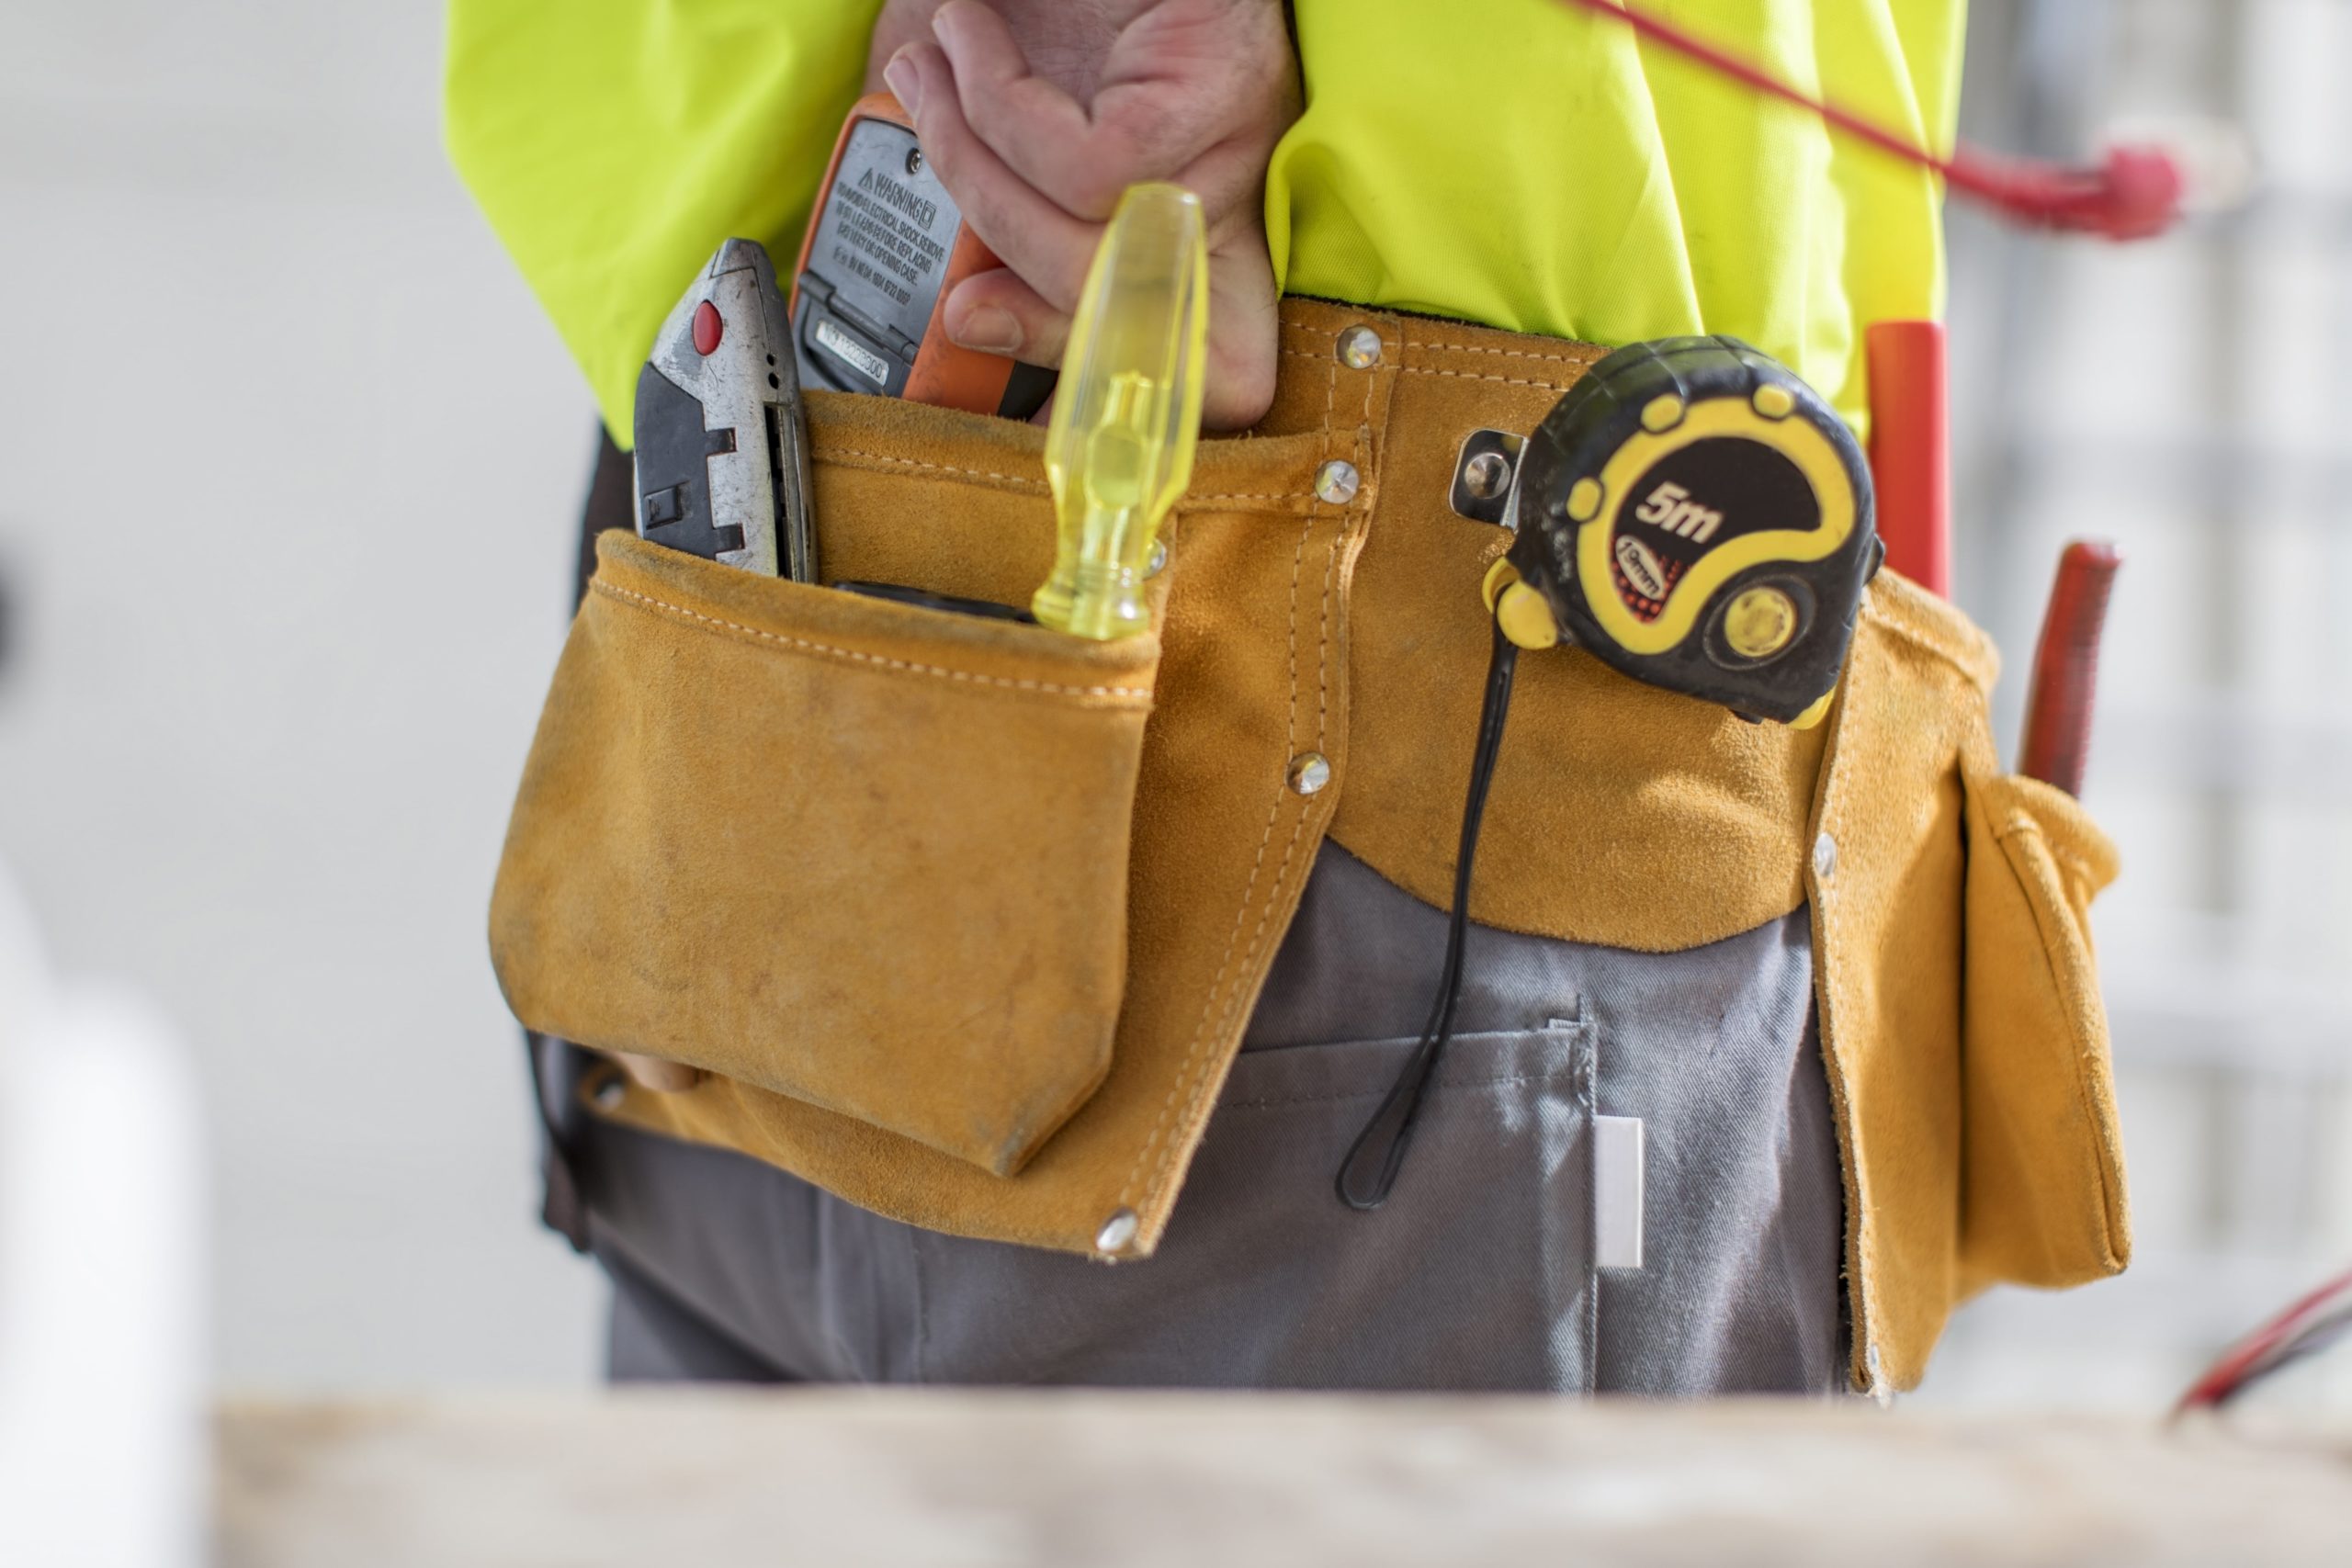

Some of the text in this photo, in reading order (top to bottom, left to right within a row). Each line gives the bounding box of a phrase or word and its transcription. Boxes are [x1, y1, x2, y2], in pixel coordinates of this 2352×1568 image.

[874, 173, 923, 220] WARNING
[836, 221, 867, 250] BATTERY
[874, 245, 903, 273] OPENING
[851, 210, 875, 235] LEADS
[871, 225, 899, 251] BEFORE
[896, 241, 933, 273] REPLACING
[861, 197, 899, 232] ELECTRICAL
[917, 235, 945, 262] REMOVE
[1635, 481, 1724, 545] 5m
[1619, 541, 1659, 594] 19mm
